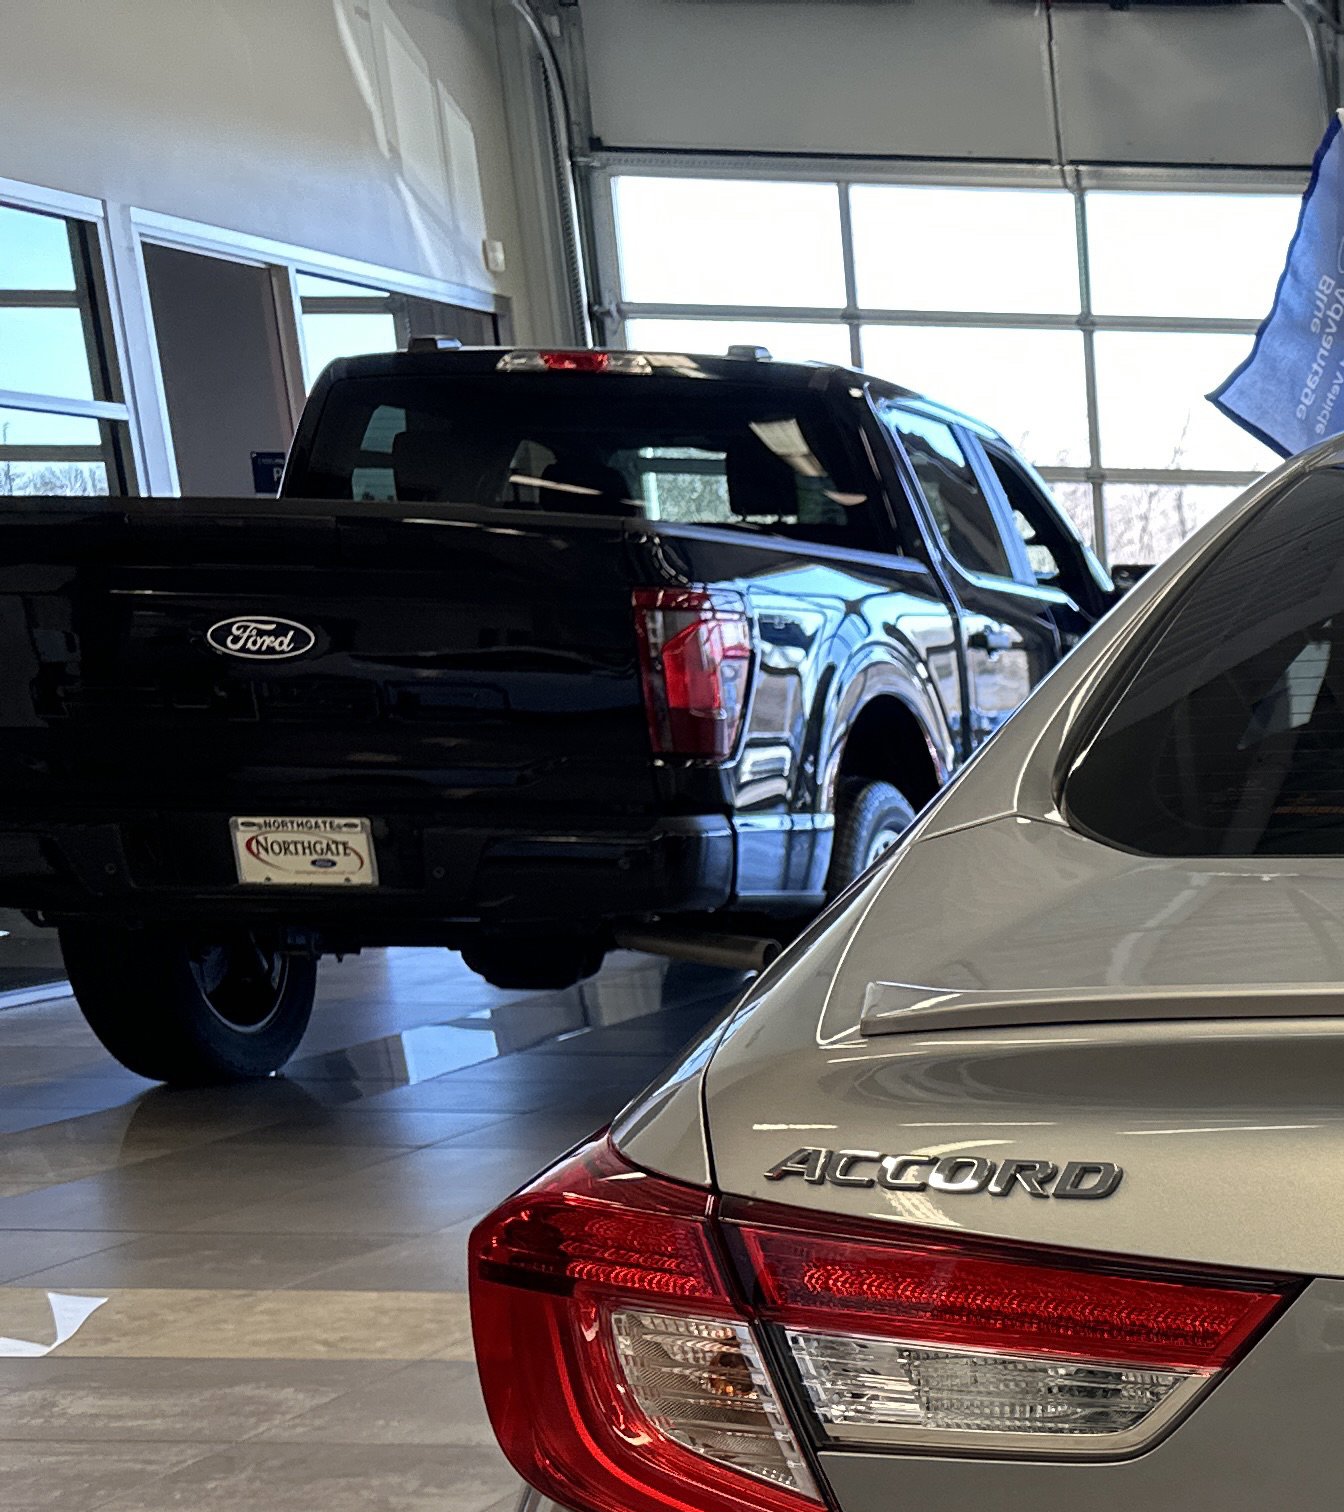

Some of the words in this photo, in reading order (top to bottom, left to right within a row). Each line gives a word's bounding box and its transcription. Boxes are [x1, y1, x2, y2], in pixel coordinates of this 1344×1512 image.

[226, 621, 295, 651] Ford
[263, 819, 336, 830] NORTHGATE
[763, 1146, 1124, 1199] ACCORD
